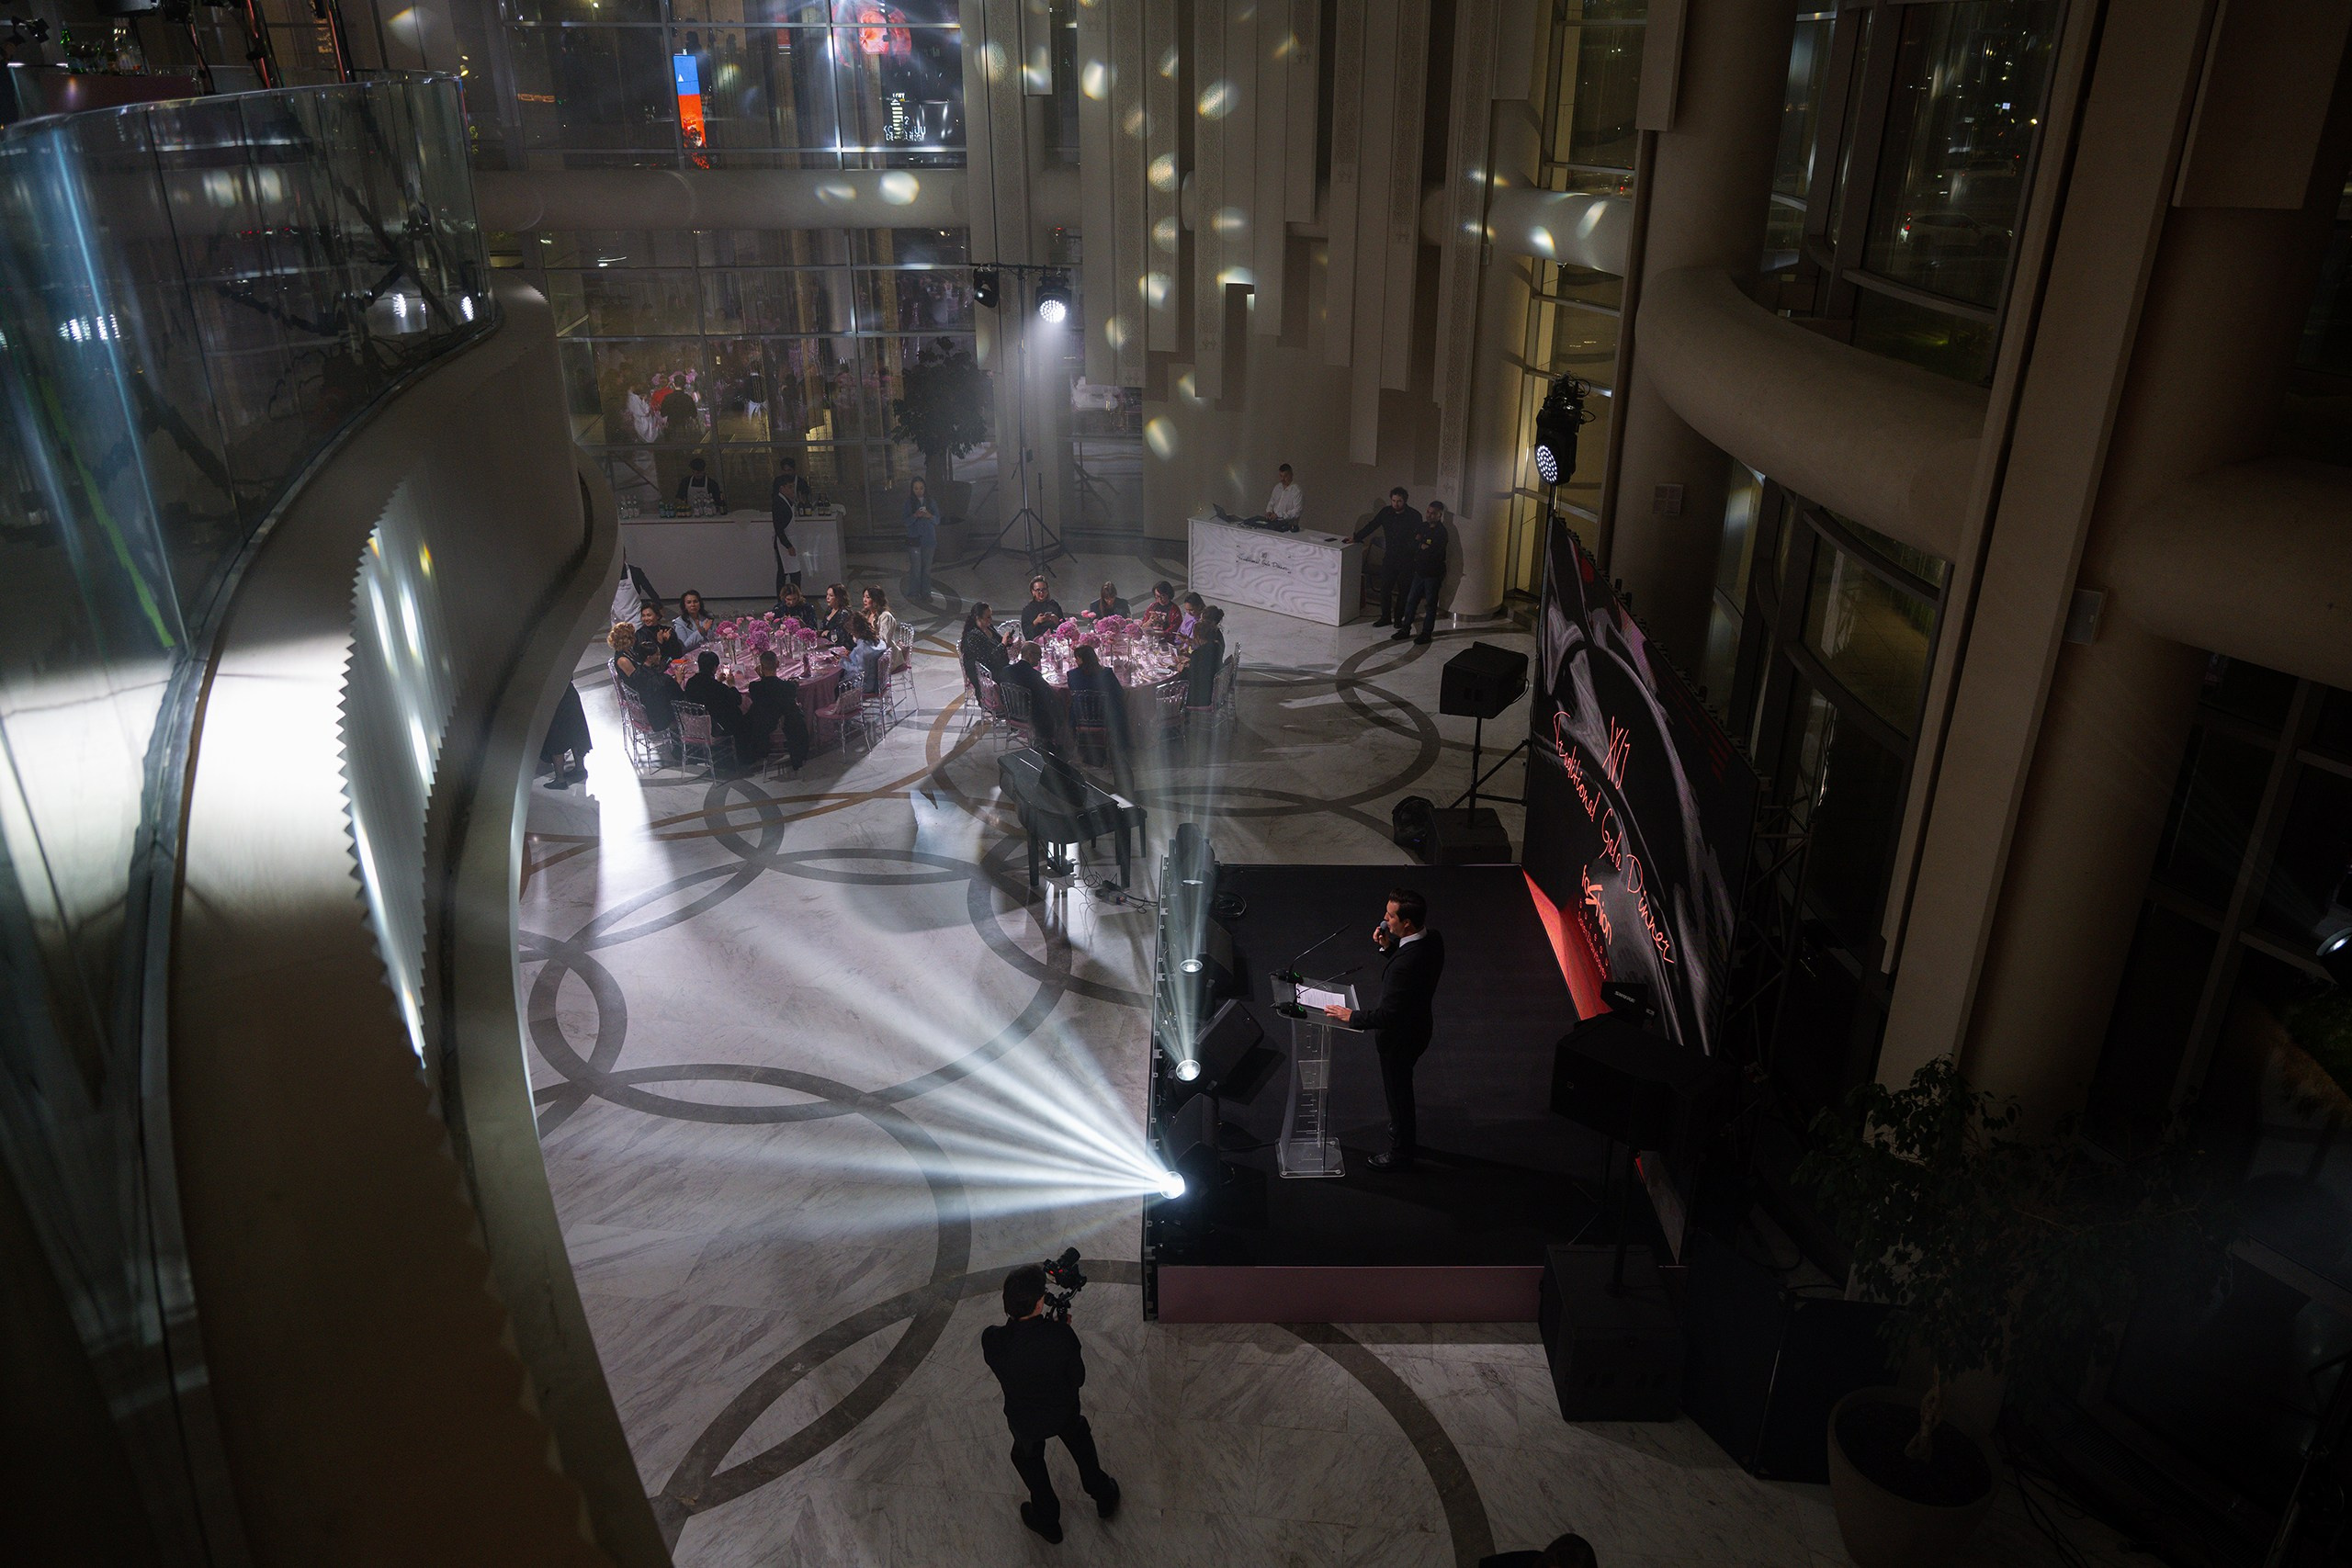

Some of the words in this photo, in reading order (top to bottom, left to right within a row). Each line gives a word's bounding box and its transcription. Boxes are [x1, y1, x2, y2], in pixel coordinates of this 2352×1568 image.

[1553, 711, 1601, 822] Traditional
[1599, 807, 1623, 872] Gala
[1626, 853, 1675, 964] Dinner
